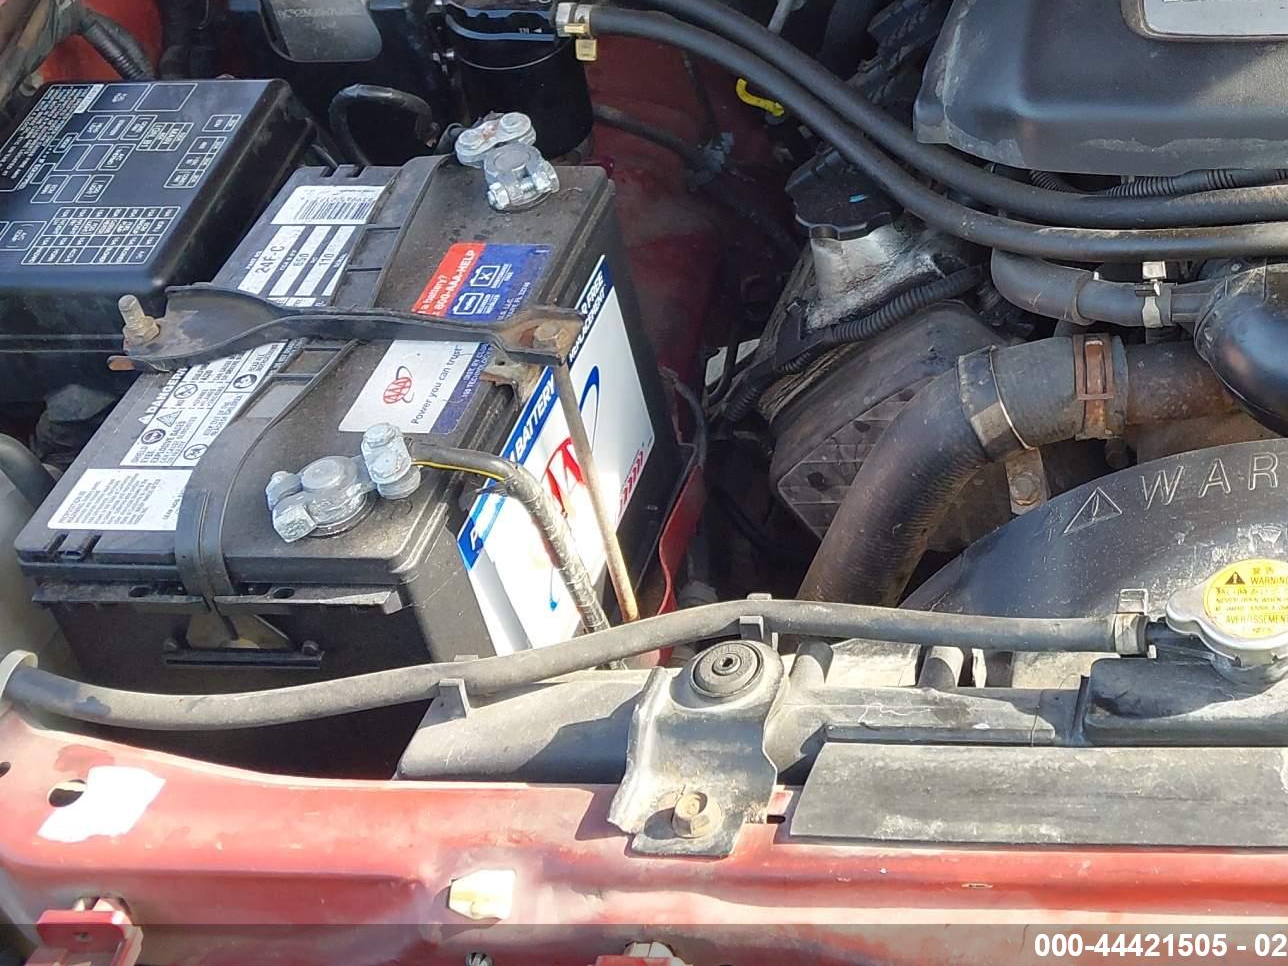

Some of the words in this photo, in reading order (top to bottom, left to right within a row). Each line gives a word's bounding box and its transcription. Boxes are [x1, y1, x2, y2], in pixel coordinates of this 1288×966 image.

[255, 245, 285, 274] 24F-C
[318, 253, 335, 267] 110
[426, 275, 448, 305] battery?
[586, 270, 605, 306] FREE
[411, 397, 432, 424] Power
[429, 382, 442, 398] you
[439, 366, 452, 381] can
[514, 380, 555, 462] BATTERY
